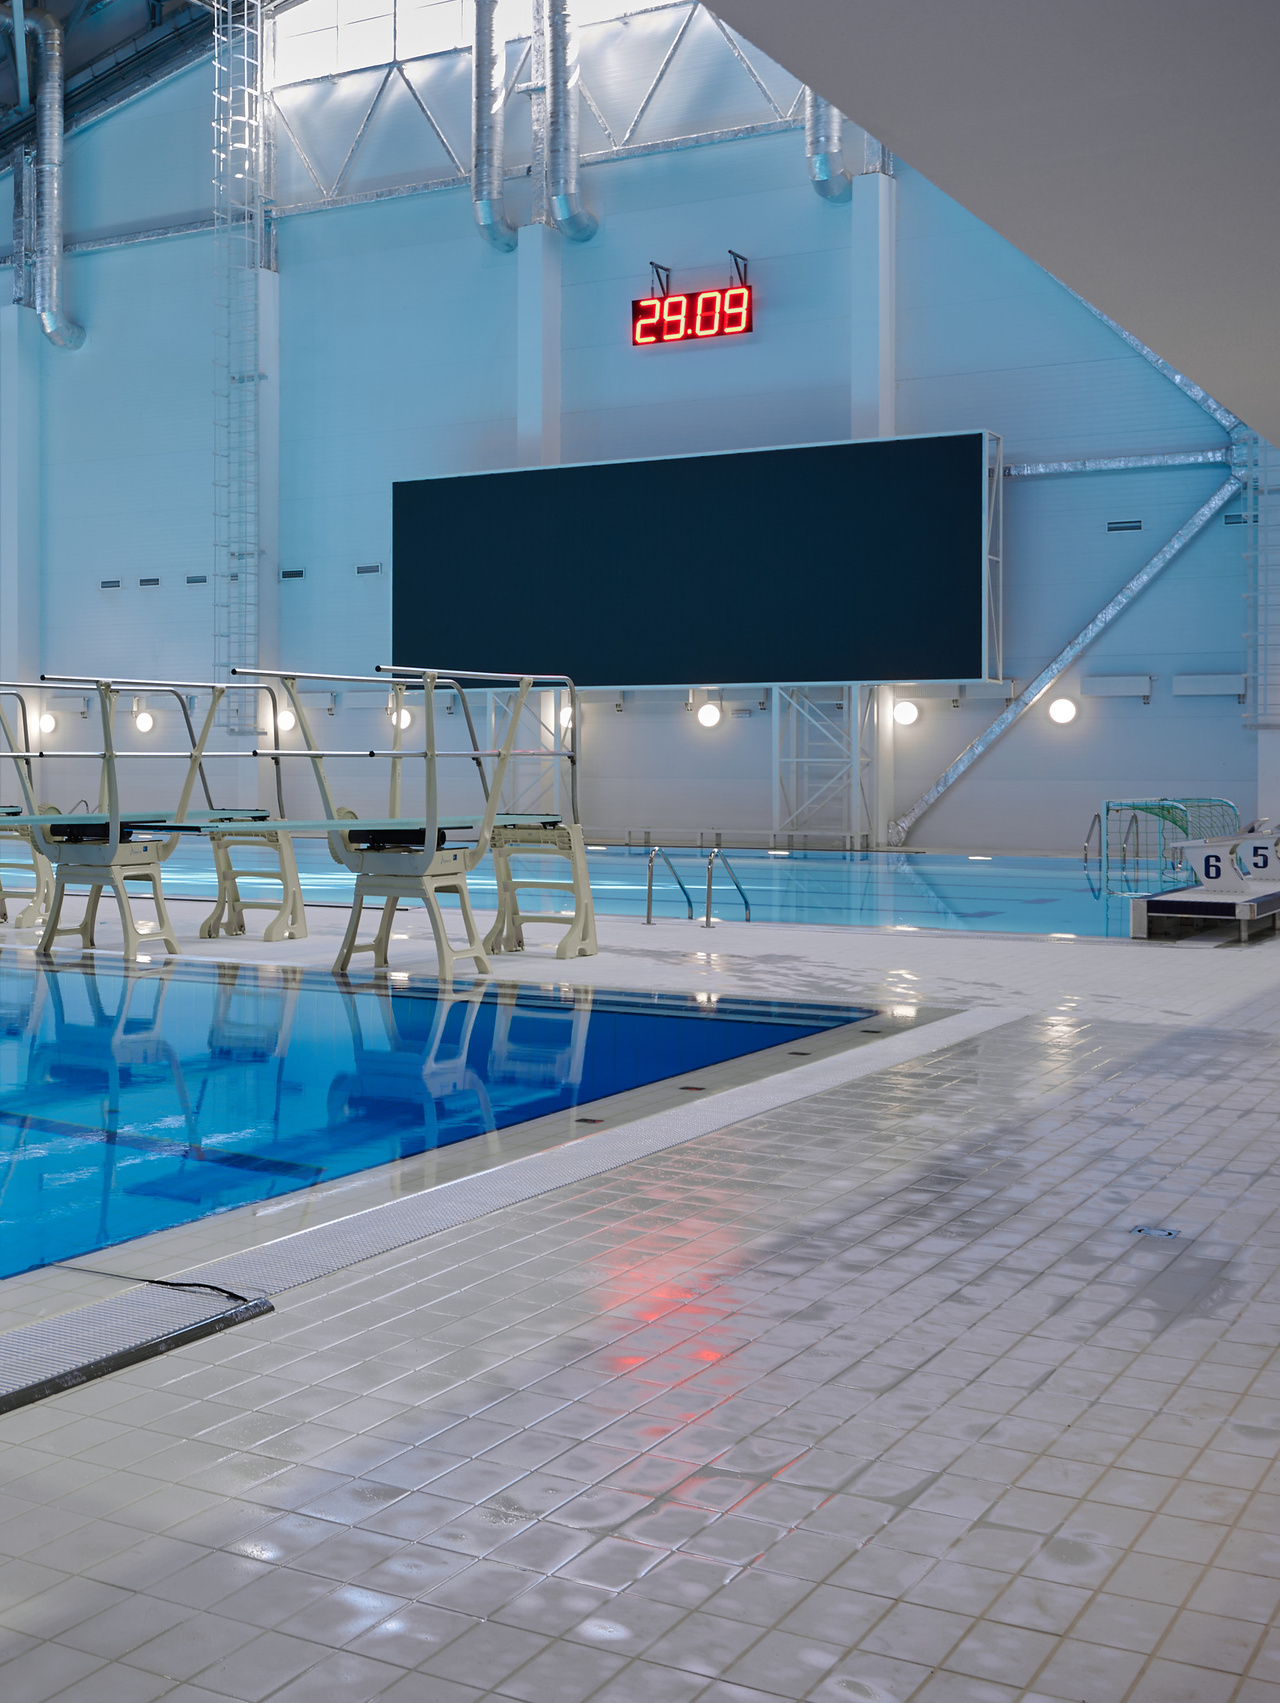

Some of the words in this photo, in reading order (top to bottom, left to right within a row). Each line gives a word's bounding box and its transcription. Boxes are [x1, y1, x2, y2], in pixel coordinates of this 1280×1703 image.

[635, 287, 749, 344] 29.09
[1204, 854, 1221, 879] 6
[1252, 846, 1269, 869] 5
